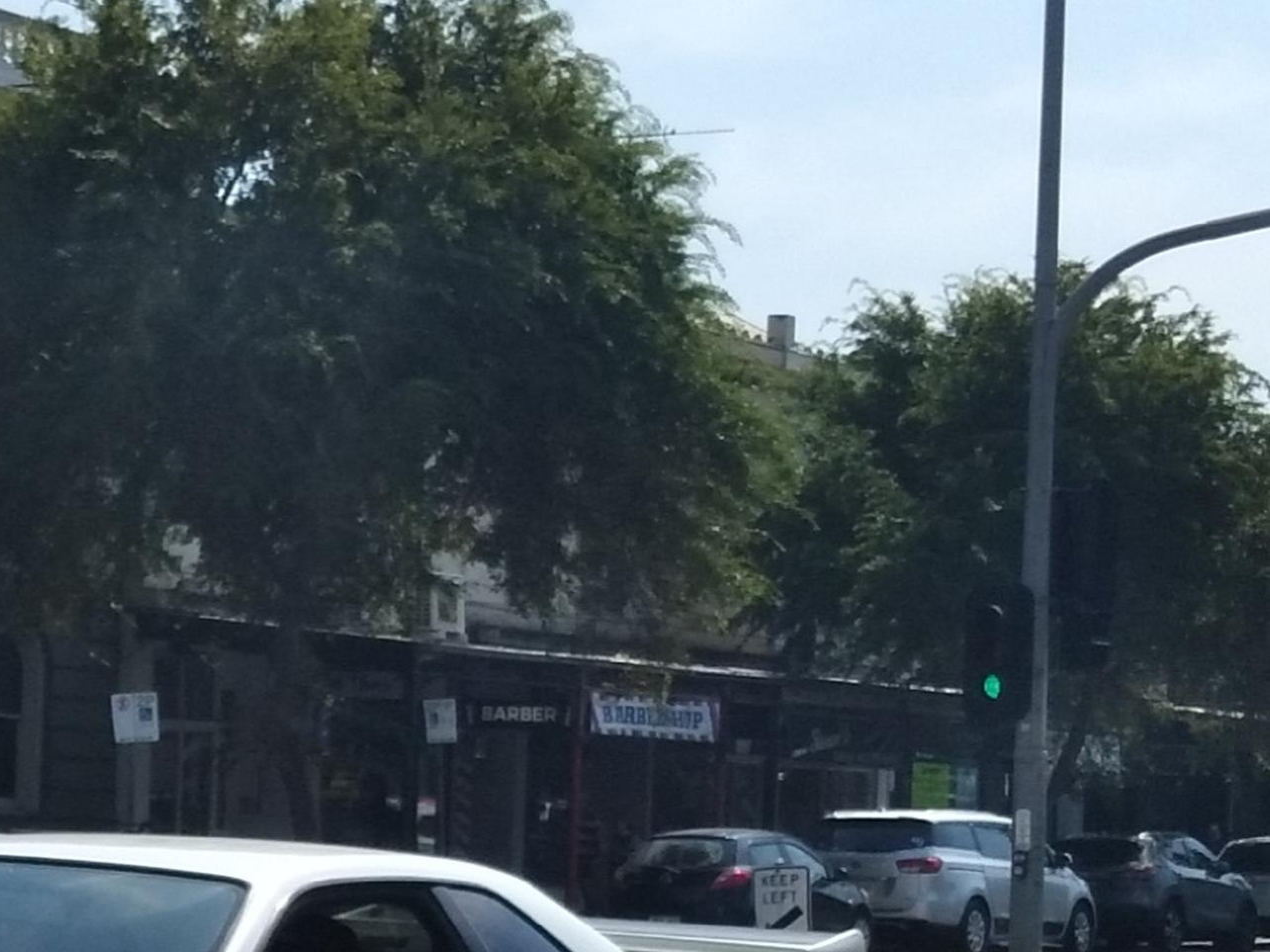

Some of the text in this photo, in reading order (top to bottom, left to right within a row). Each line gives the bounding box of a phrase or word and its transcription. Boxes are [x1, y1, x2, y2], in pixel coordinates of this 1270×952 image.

[481, 705, 557, 722] BARBER
[602, 705, 703, 731] BARBHOP
[762, 873, 799, 887] KEEP
[762, 890, 797, 905] LEFT
